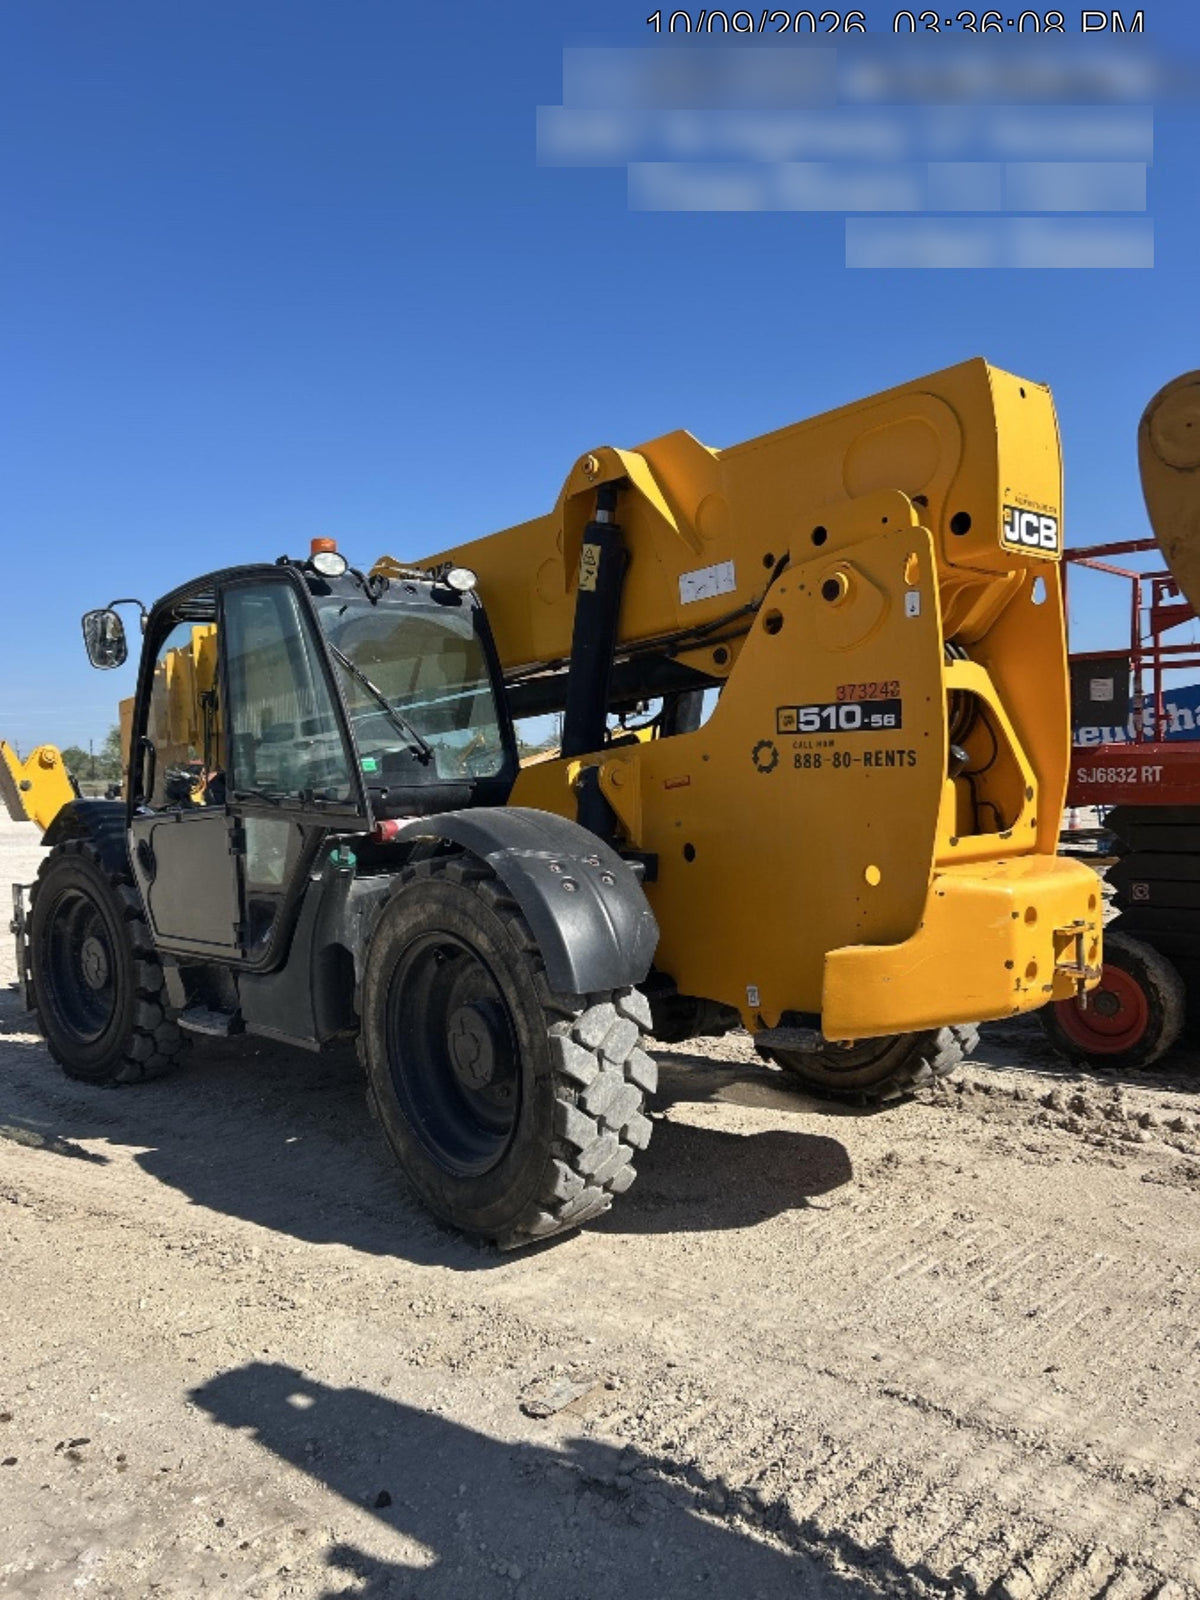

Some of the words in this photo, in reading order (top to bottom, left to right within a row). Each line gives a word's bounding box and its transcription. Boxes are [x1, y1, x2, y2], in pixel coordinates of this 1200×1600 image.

[1004, 509, 1057, 549] JCB
[798, 703, 896, 731] 510-56
[794, 750, 917, 769] 888-80-RENTS
[1077, 767, 1137, 783] SJ6832
[1141, 765, 1163, 782] RT
